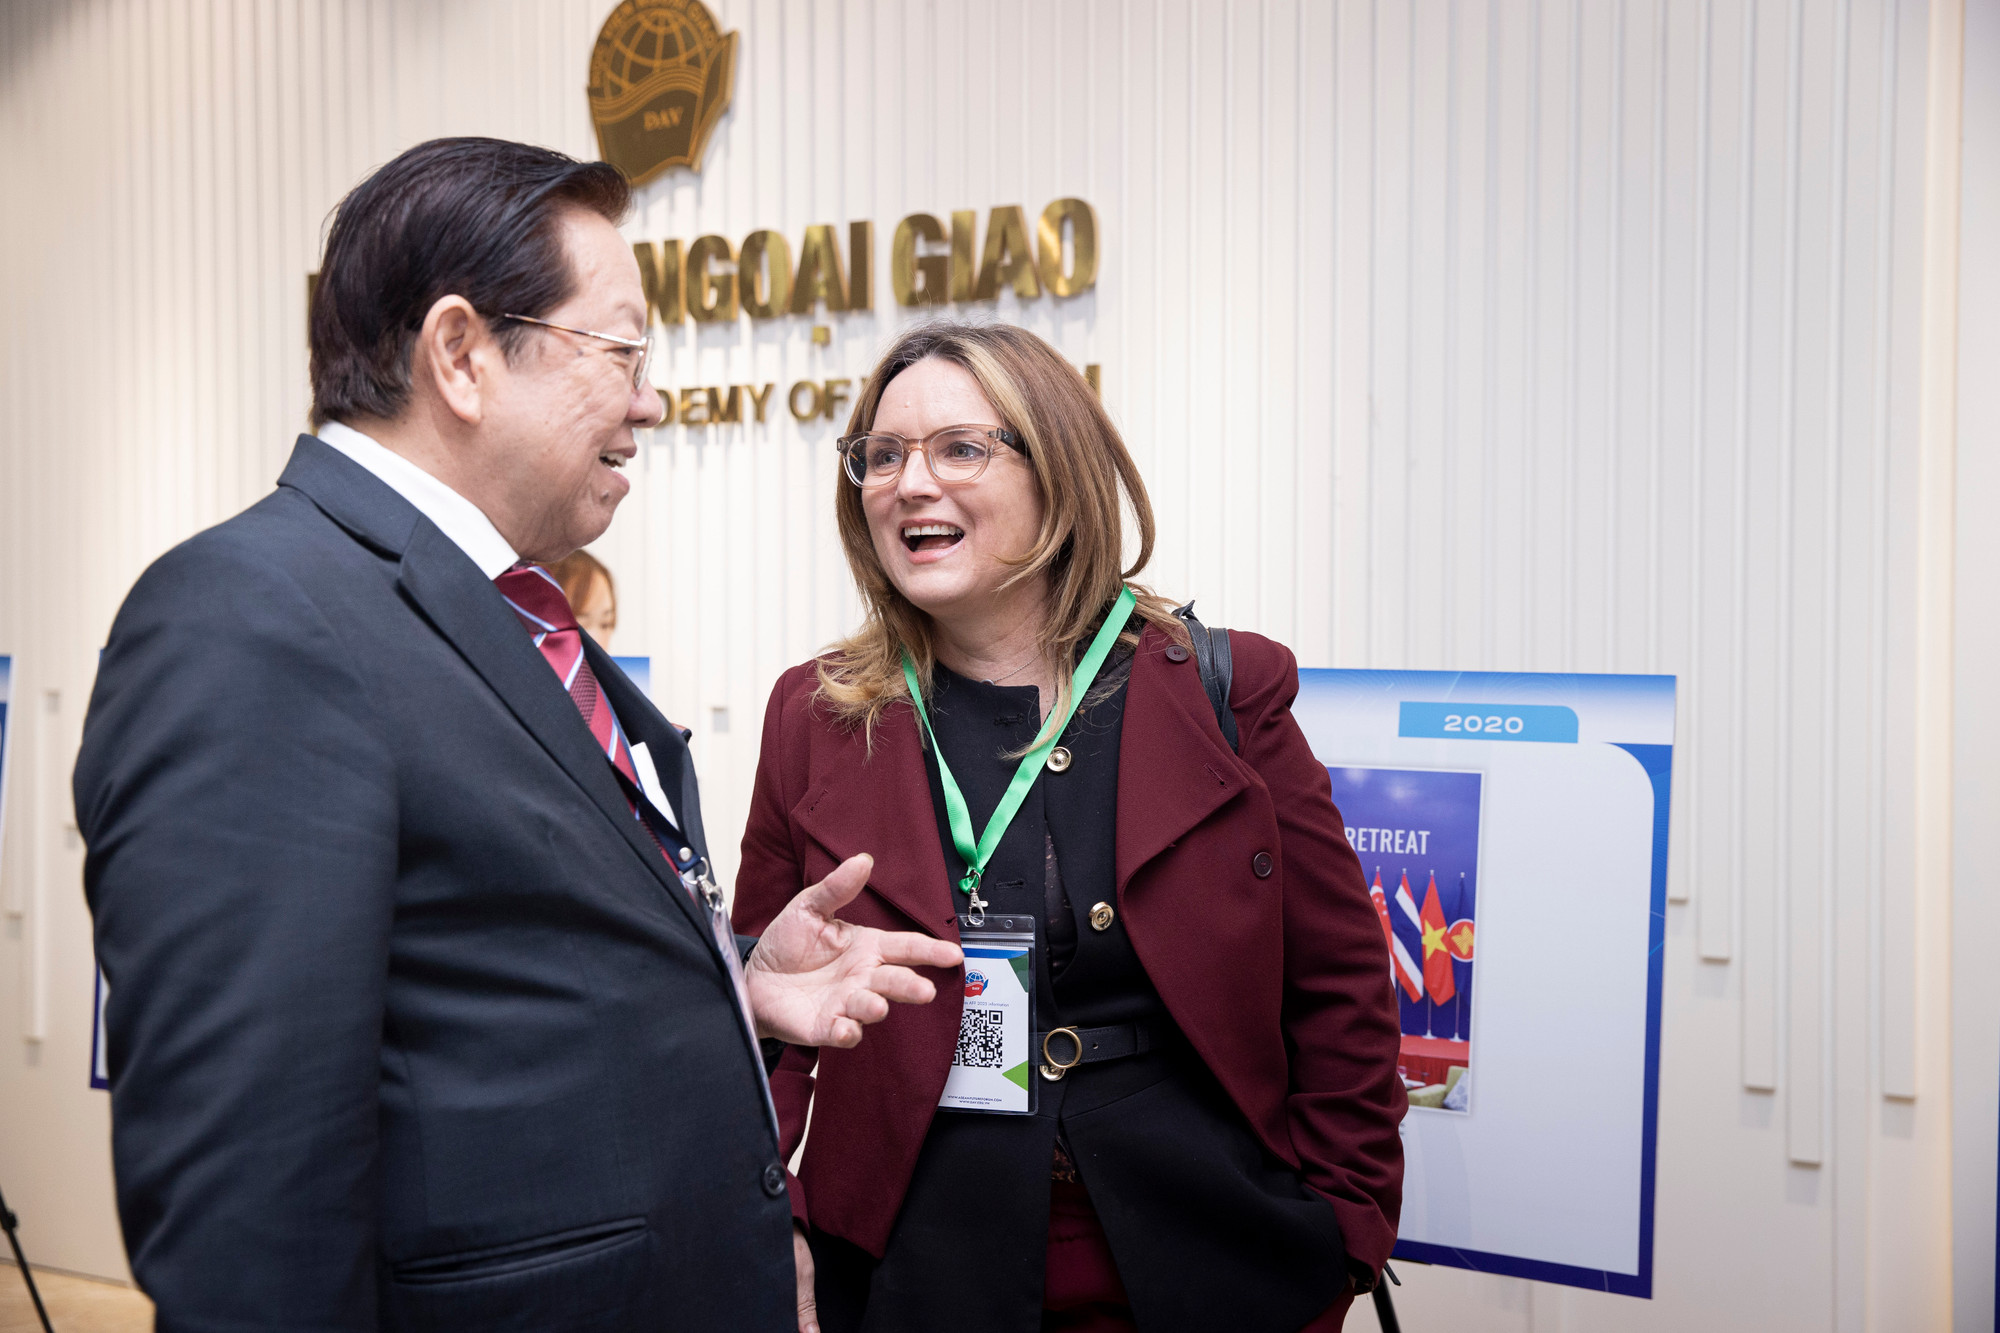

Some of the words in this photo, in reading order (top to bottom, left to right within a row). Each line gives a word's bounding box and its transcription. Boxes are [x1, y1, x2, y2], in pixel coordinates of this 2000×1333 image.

[643, 106, 684, 131] DAV
[634, 221, 873, 344] NGOẠI
[892, 197, 1100, 306] GIAO
[789, 379, 851, 421] OF
[1443, 714, 1524, 734] 2020
[1344, 827, 1430, 855] RETREAT
